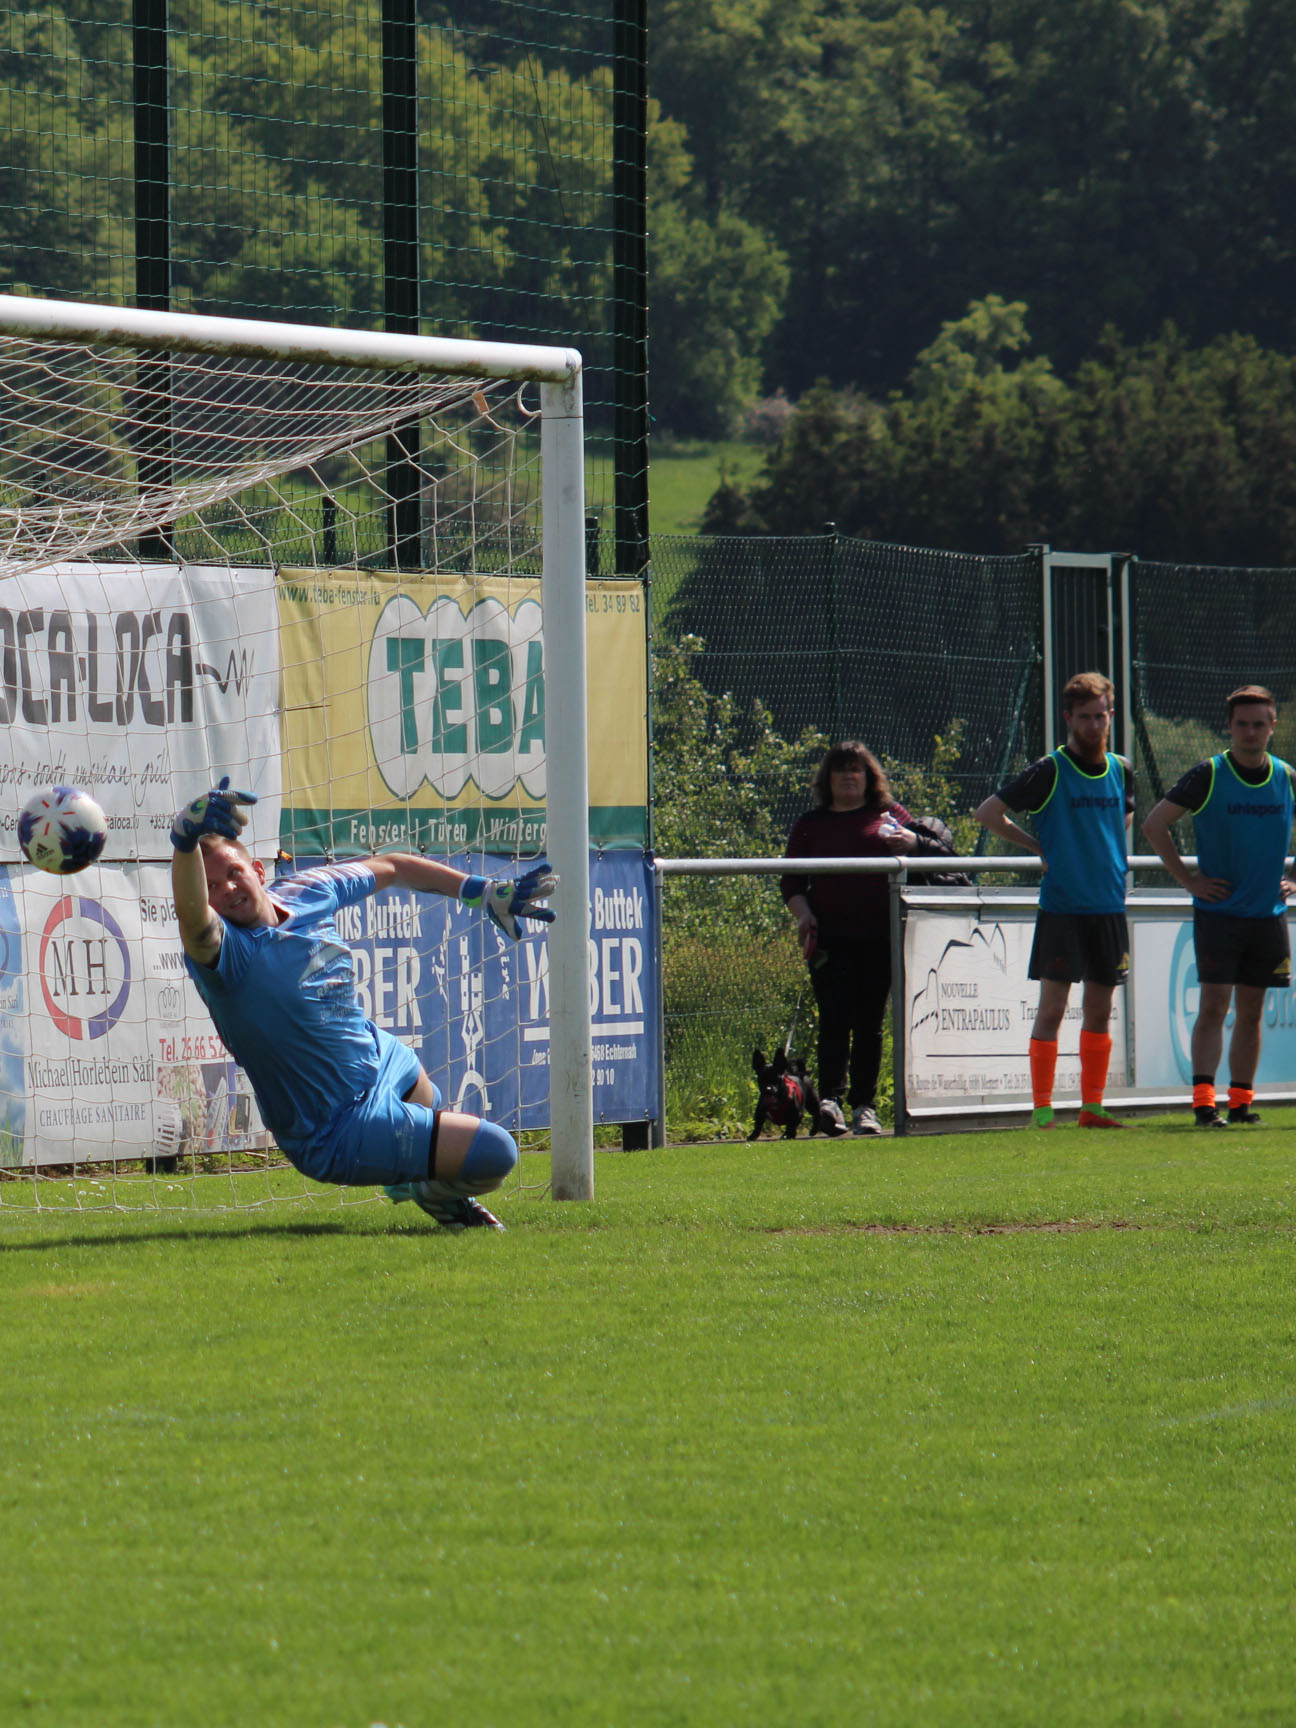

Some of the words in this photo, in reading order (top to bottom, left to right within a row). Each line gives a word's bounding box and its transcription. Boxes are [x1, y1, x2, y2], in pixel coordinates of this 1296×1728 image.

[350, 818, 406, 844] Fenster
[428, 816, 468, 842] Türen
[141, 898, 158, 922] Sie
[365, 893, 423, 940] Buttek
[594, 886, 644, 931] Buttek
[941, 982, 979, 999] NOUVELLE
[159, 1036, 179, 1062] Tel.
[195, 1035, 206, 1059] 66
[28, 1059, 70, 1089] Michael
[71, 1056, 131, 1087] Horlebein
[40, 1106, 93, 1128] CHAUFFAGE
[95, 1103, 146, 1124] SANITAIRE
